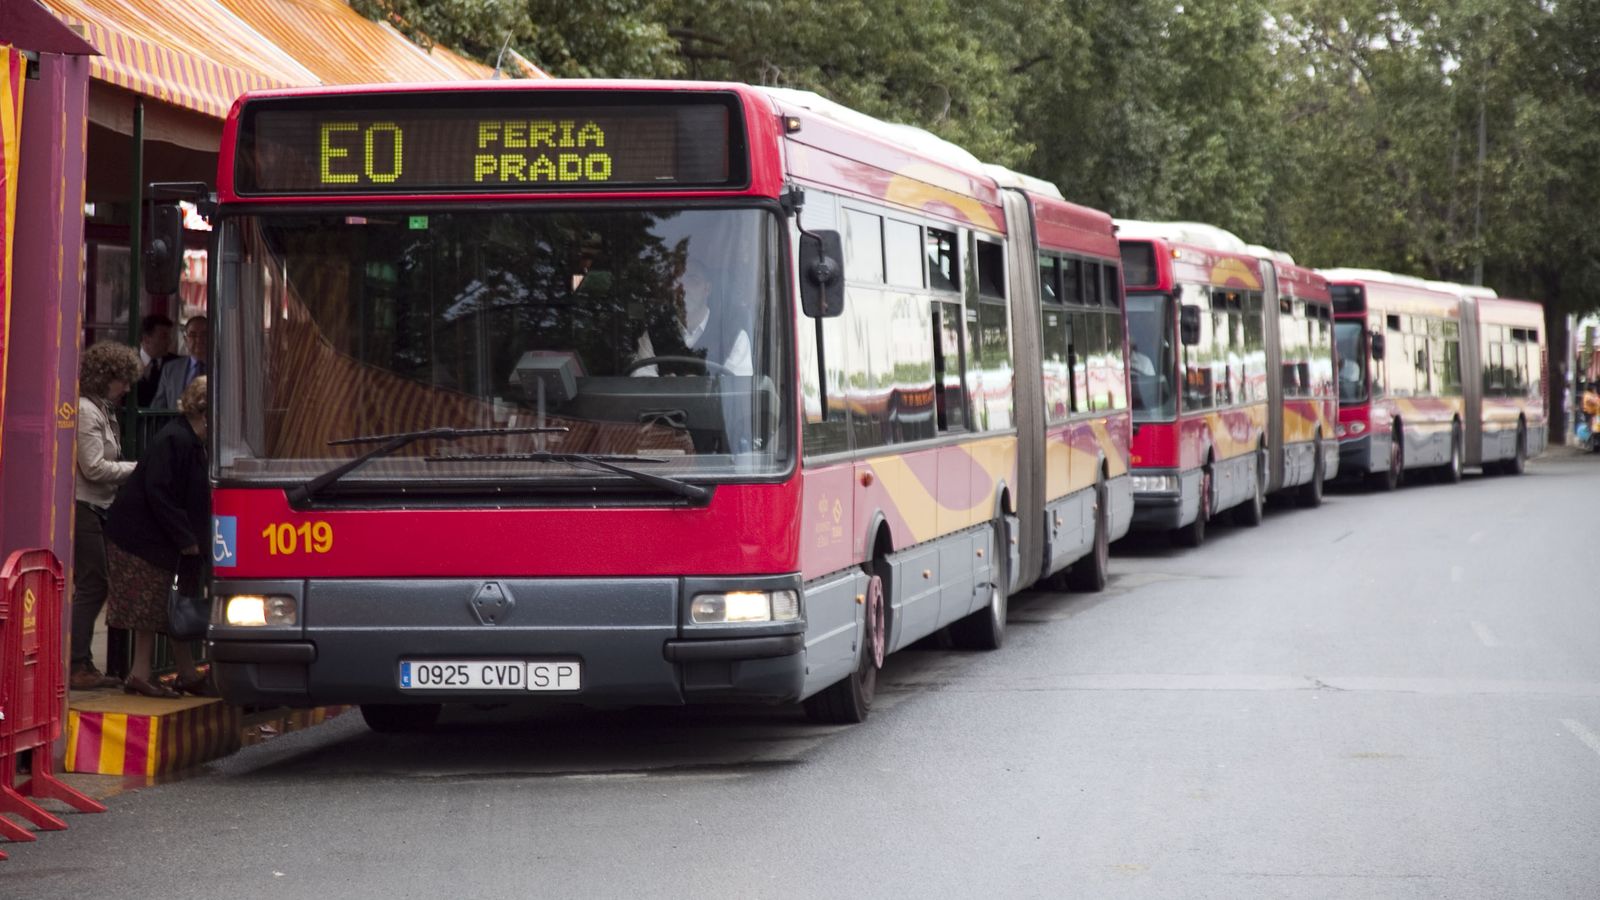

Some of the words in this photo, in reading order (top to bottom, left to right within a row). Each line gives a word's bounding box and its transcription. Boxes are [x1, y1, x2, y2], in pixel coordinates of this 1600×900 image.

[478, 120, 605, 149] FERIA
[474, 154, 612, 182] PRADO
[262, 521, 334, 555] 1019
[417, 664, 470, 685] 0925
[481, 665, 521, 685] CVD
